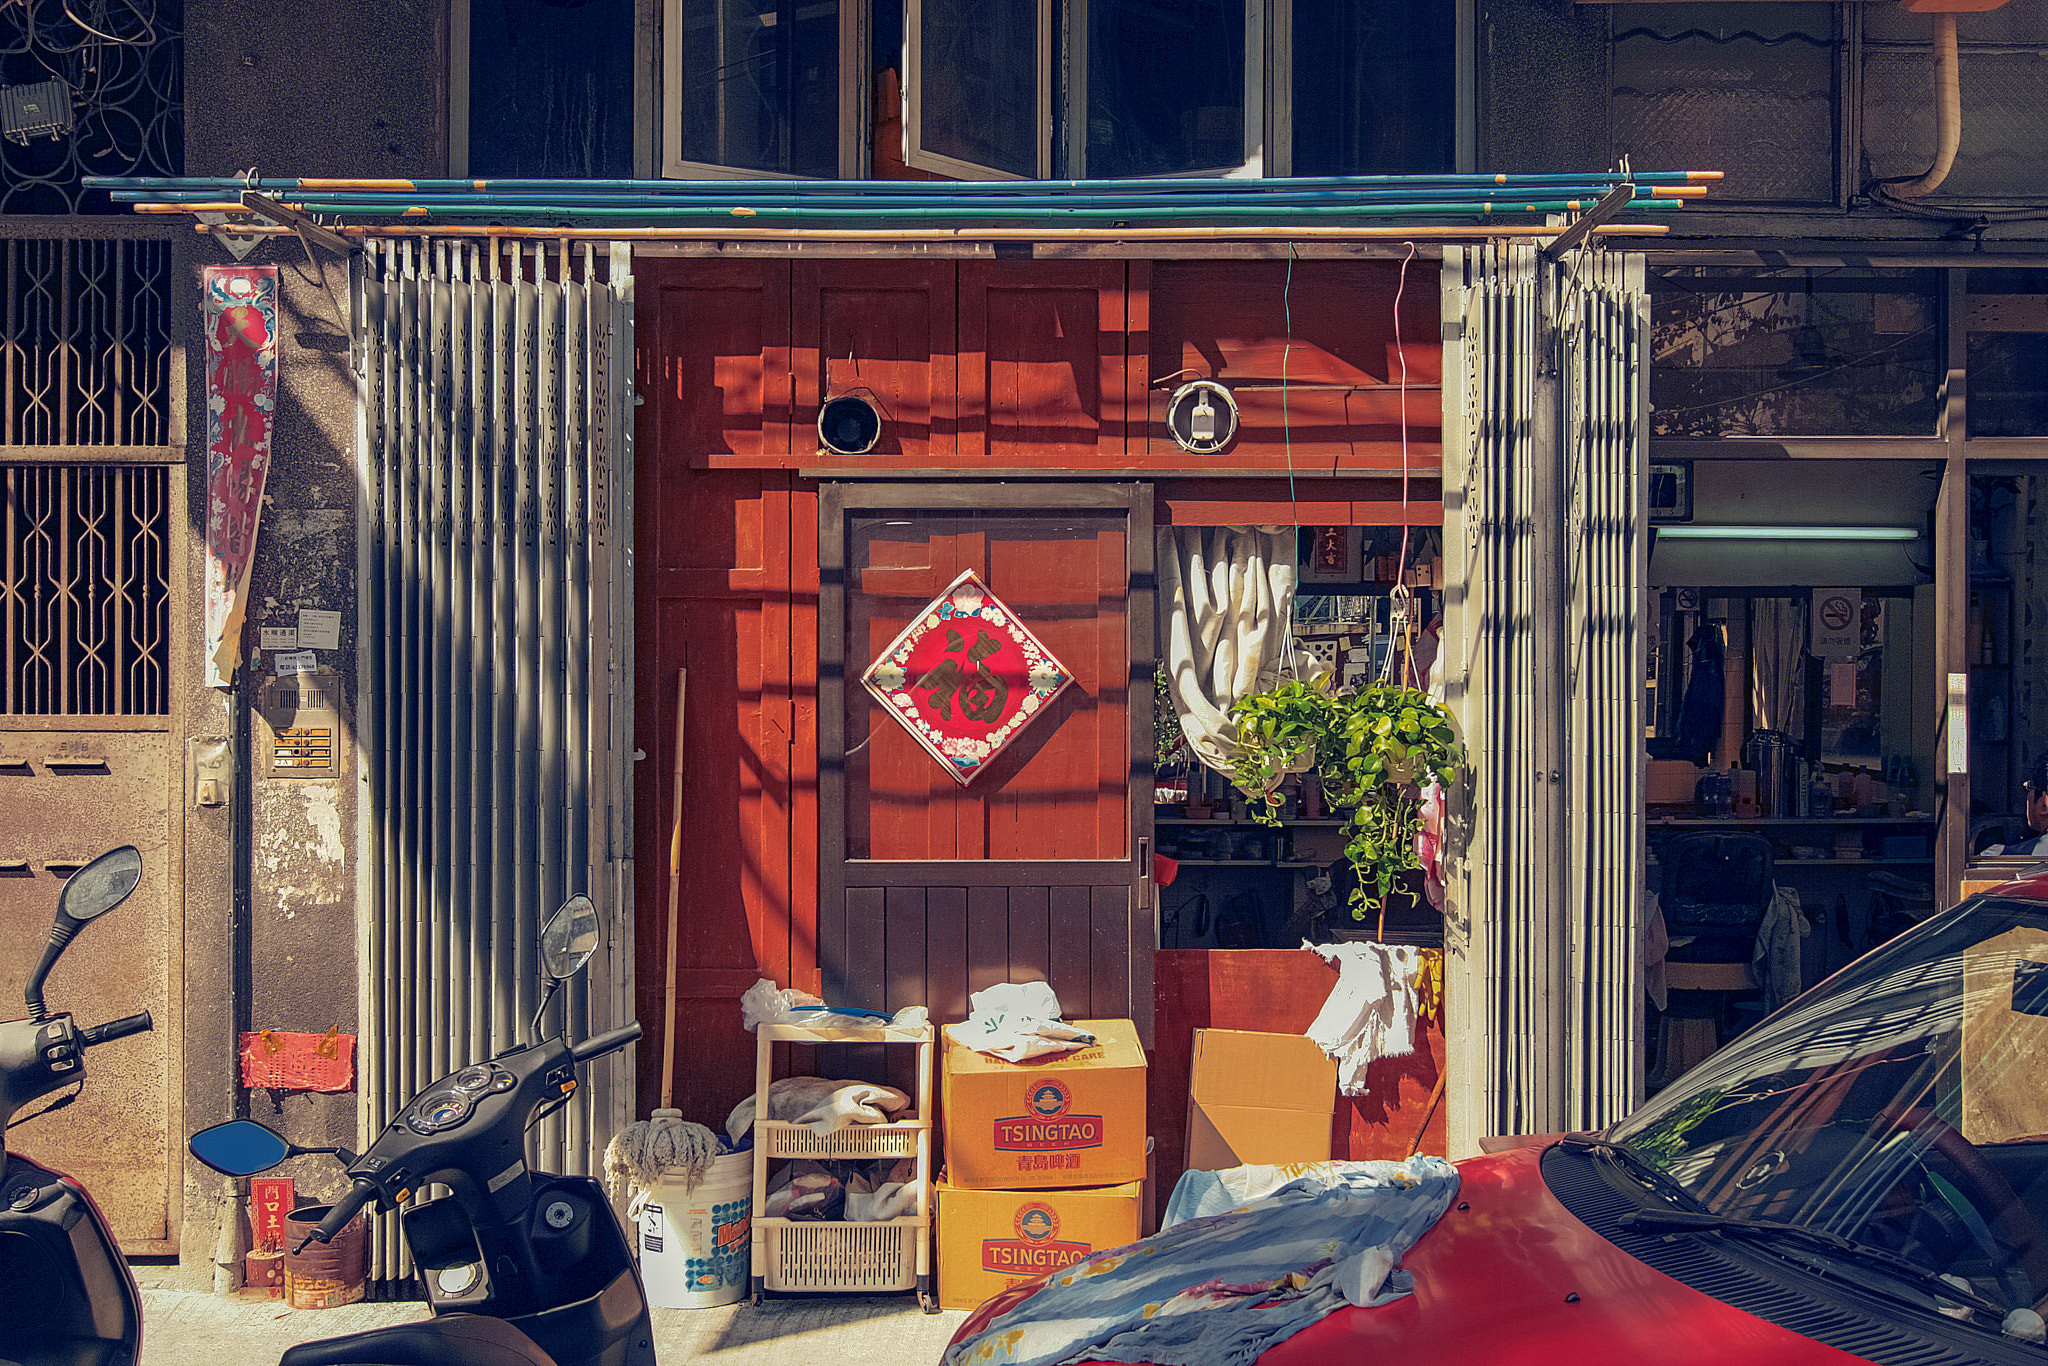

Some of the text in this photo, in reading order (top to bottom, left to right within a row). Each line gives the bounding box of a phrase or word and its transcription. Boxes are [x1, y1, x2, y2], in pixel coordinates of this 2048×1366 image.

[917, 628, 1010, 725] 福
[1072, 1051, 1105, 1062] CARE
[1001, 1122, 1096, 1143] TSINGTAO
[1016, 1153, 1081, 1172] 青島啤酒
[988, 1247, 1084, 1267] TSINGTAO
